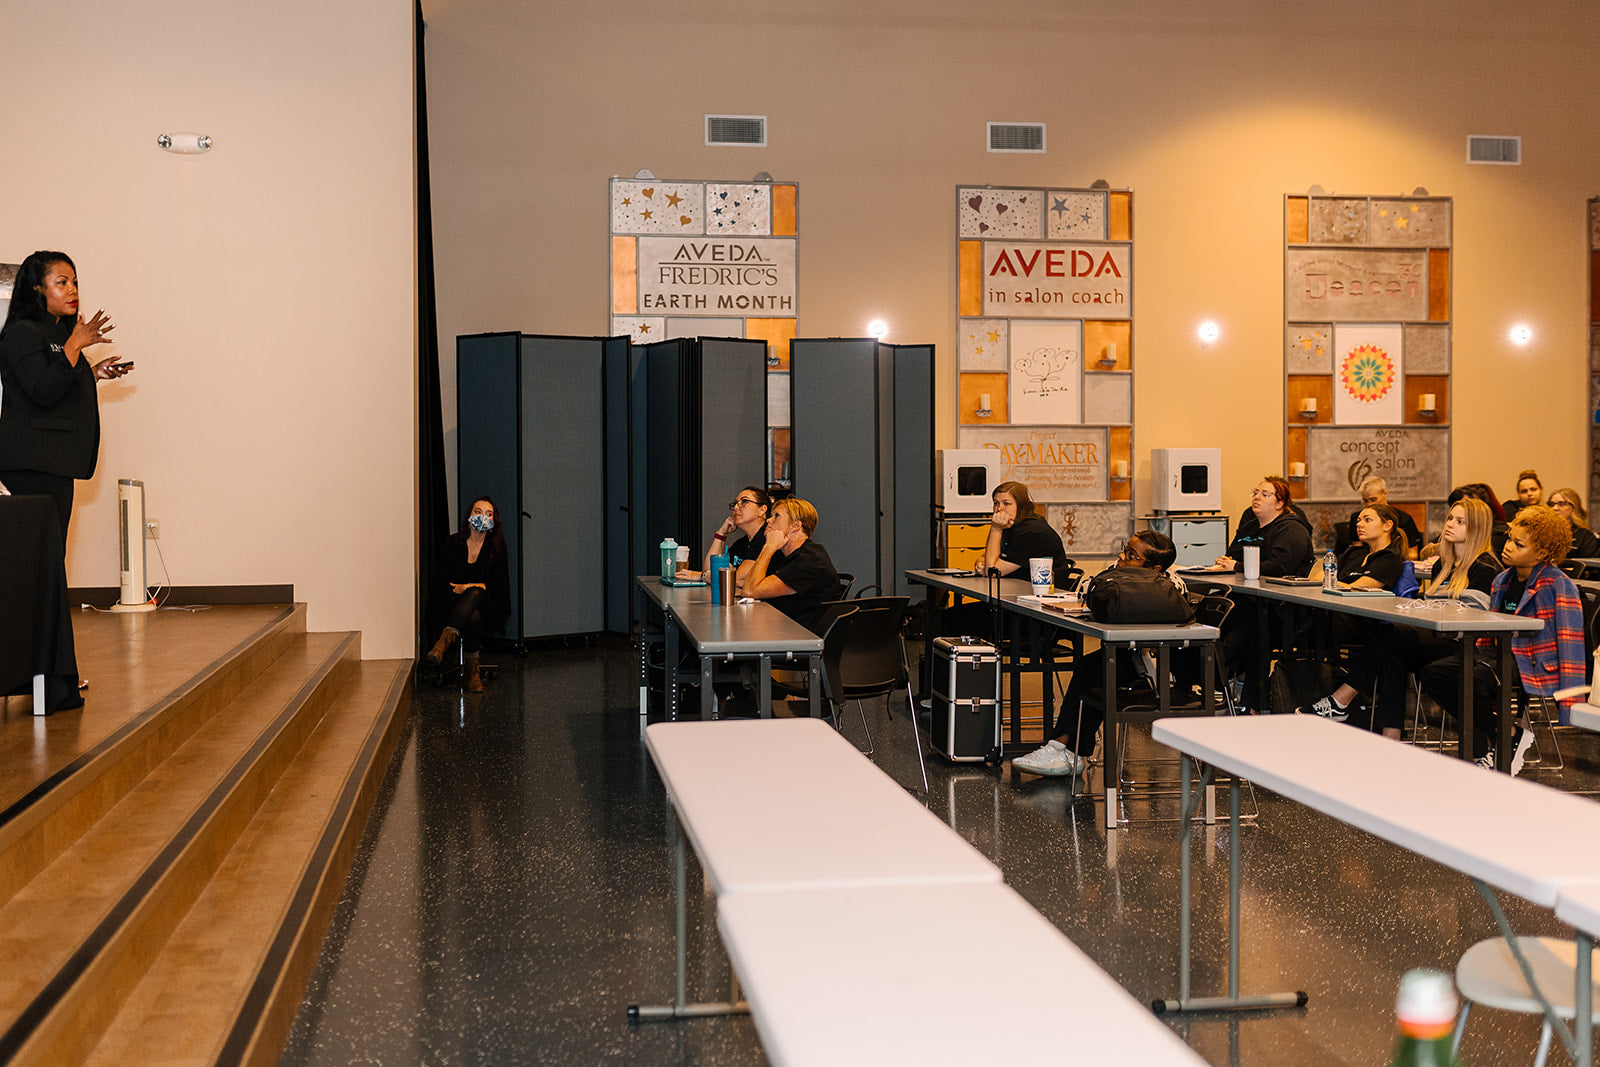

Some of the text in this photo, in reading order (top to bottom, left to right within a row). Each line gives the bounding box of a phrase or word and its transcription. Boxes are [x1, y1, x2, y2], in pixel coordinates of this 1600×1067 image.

[673, 243, 763, 262] AVEDA
[989, 248, 1122, 278] AVEDA
[658, 266, 778, 287] FREDRIC'S
[643, 293, 792, 310] EARTH MONTH
[988, 287, 1124, 304] in salon coach
[1375, 429, 1410, 439] AVEDA
[1339, 439, 1401, 455] concept
[1375, 455, 1416, 470] salon
